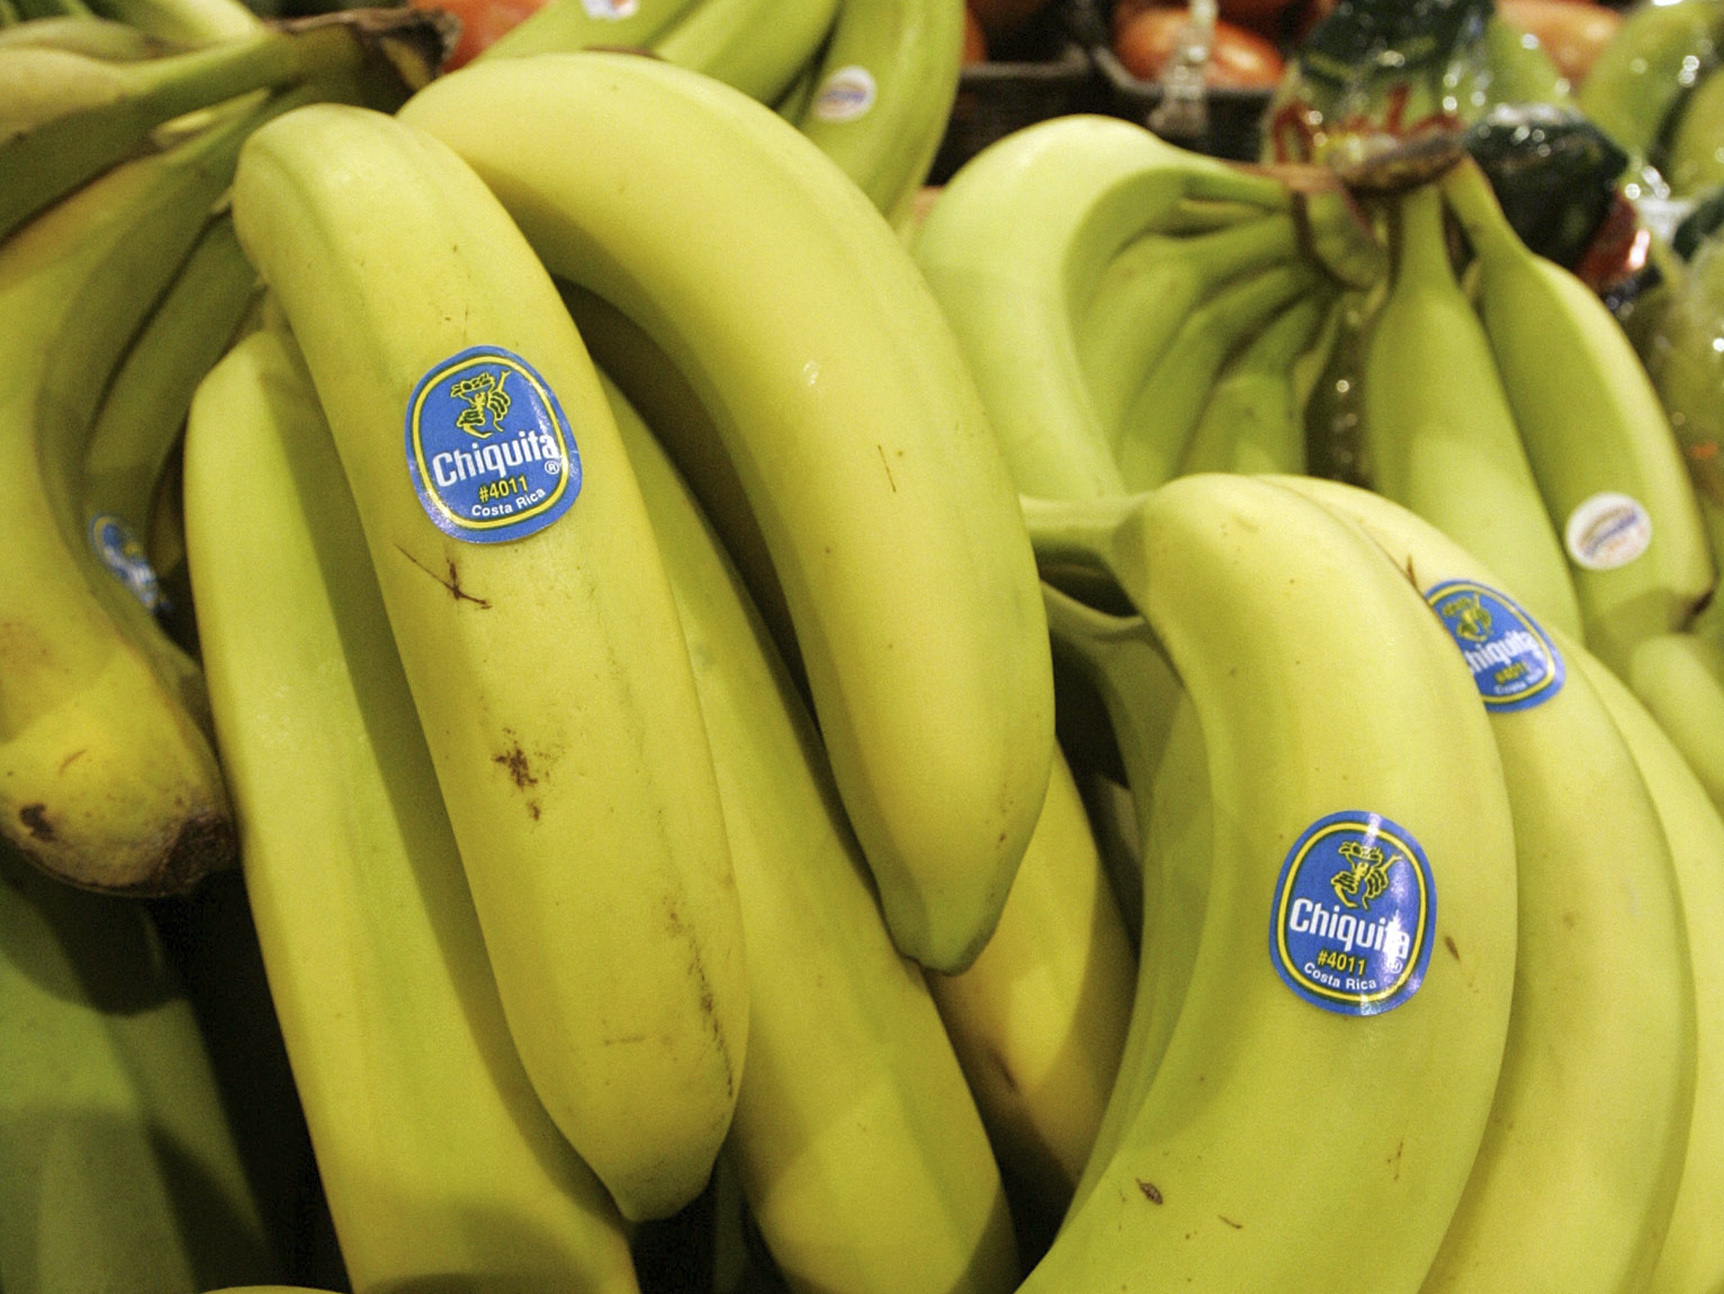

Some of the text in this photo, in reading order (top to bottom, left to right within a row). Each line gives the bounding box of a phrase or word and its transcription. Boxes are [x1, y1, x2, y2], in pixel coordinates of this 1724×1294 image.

[432, 430, 561, 488] Chiquita
[471, 488, 546, 517] Costa Rica
[479, 476, 529, 502] #4011
[1464, 630, 1540, 673] hiquita
[1304, 962, 1377, 990] Costa Rica
[1317, 950, 1366, 976] #4011
